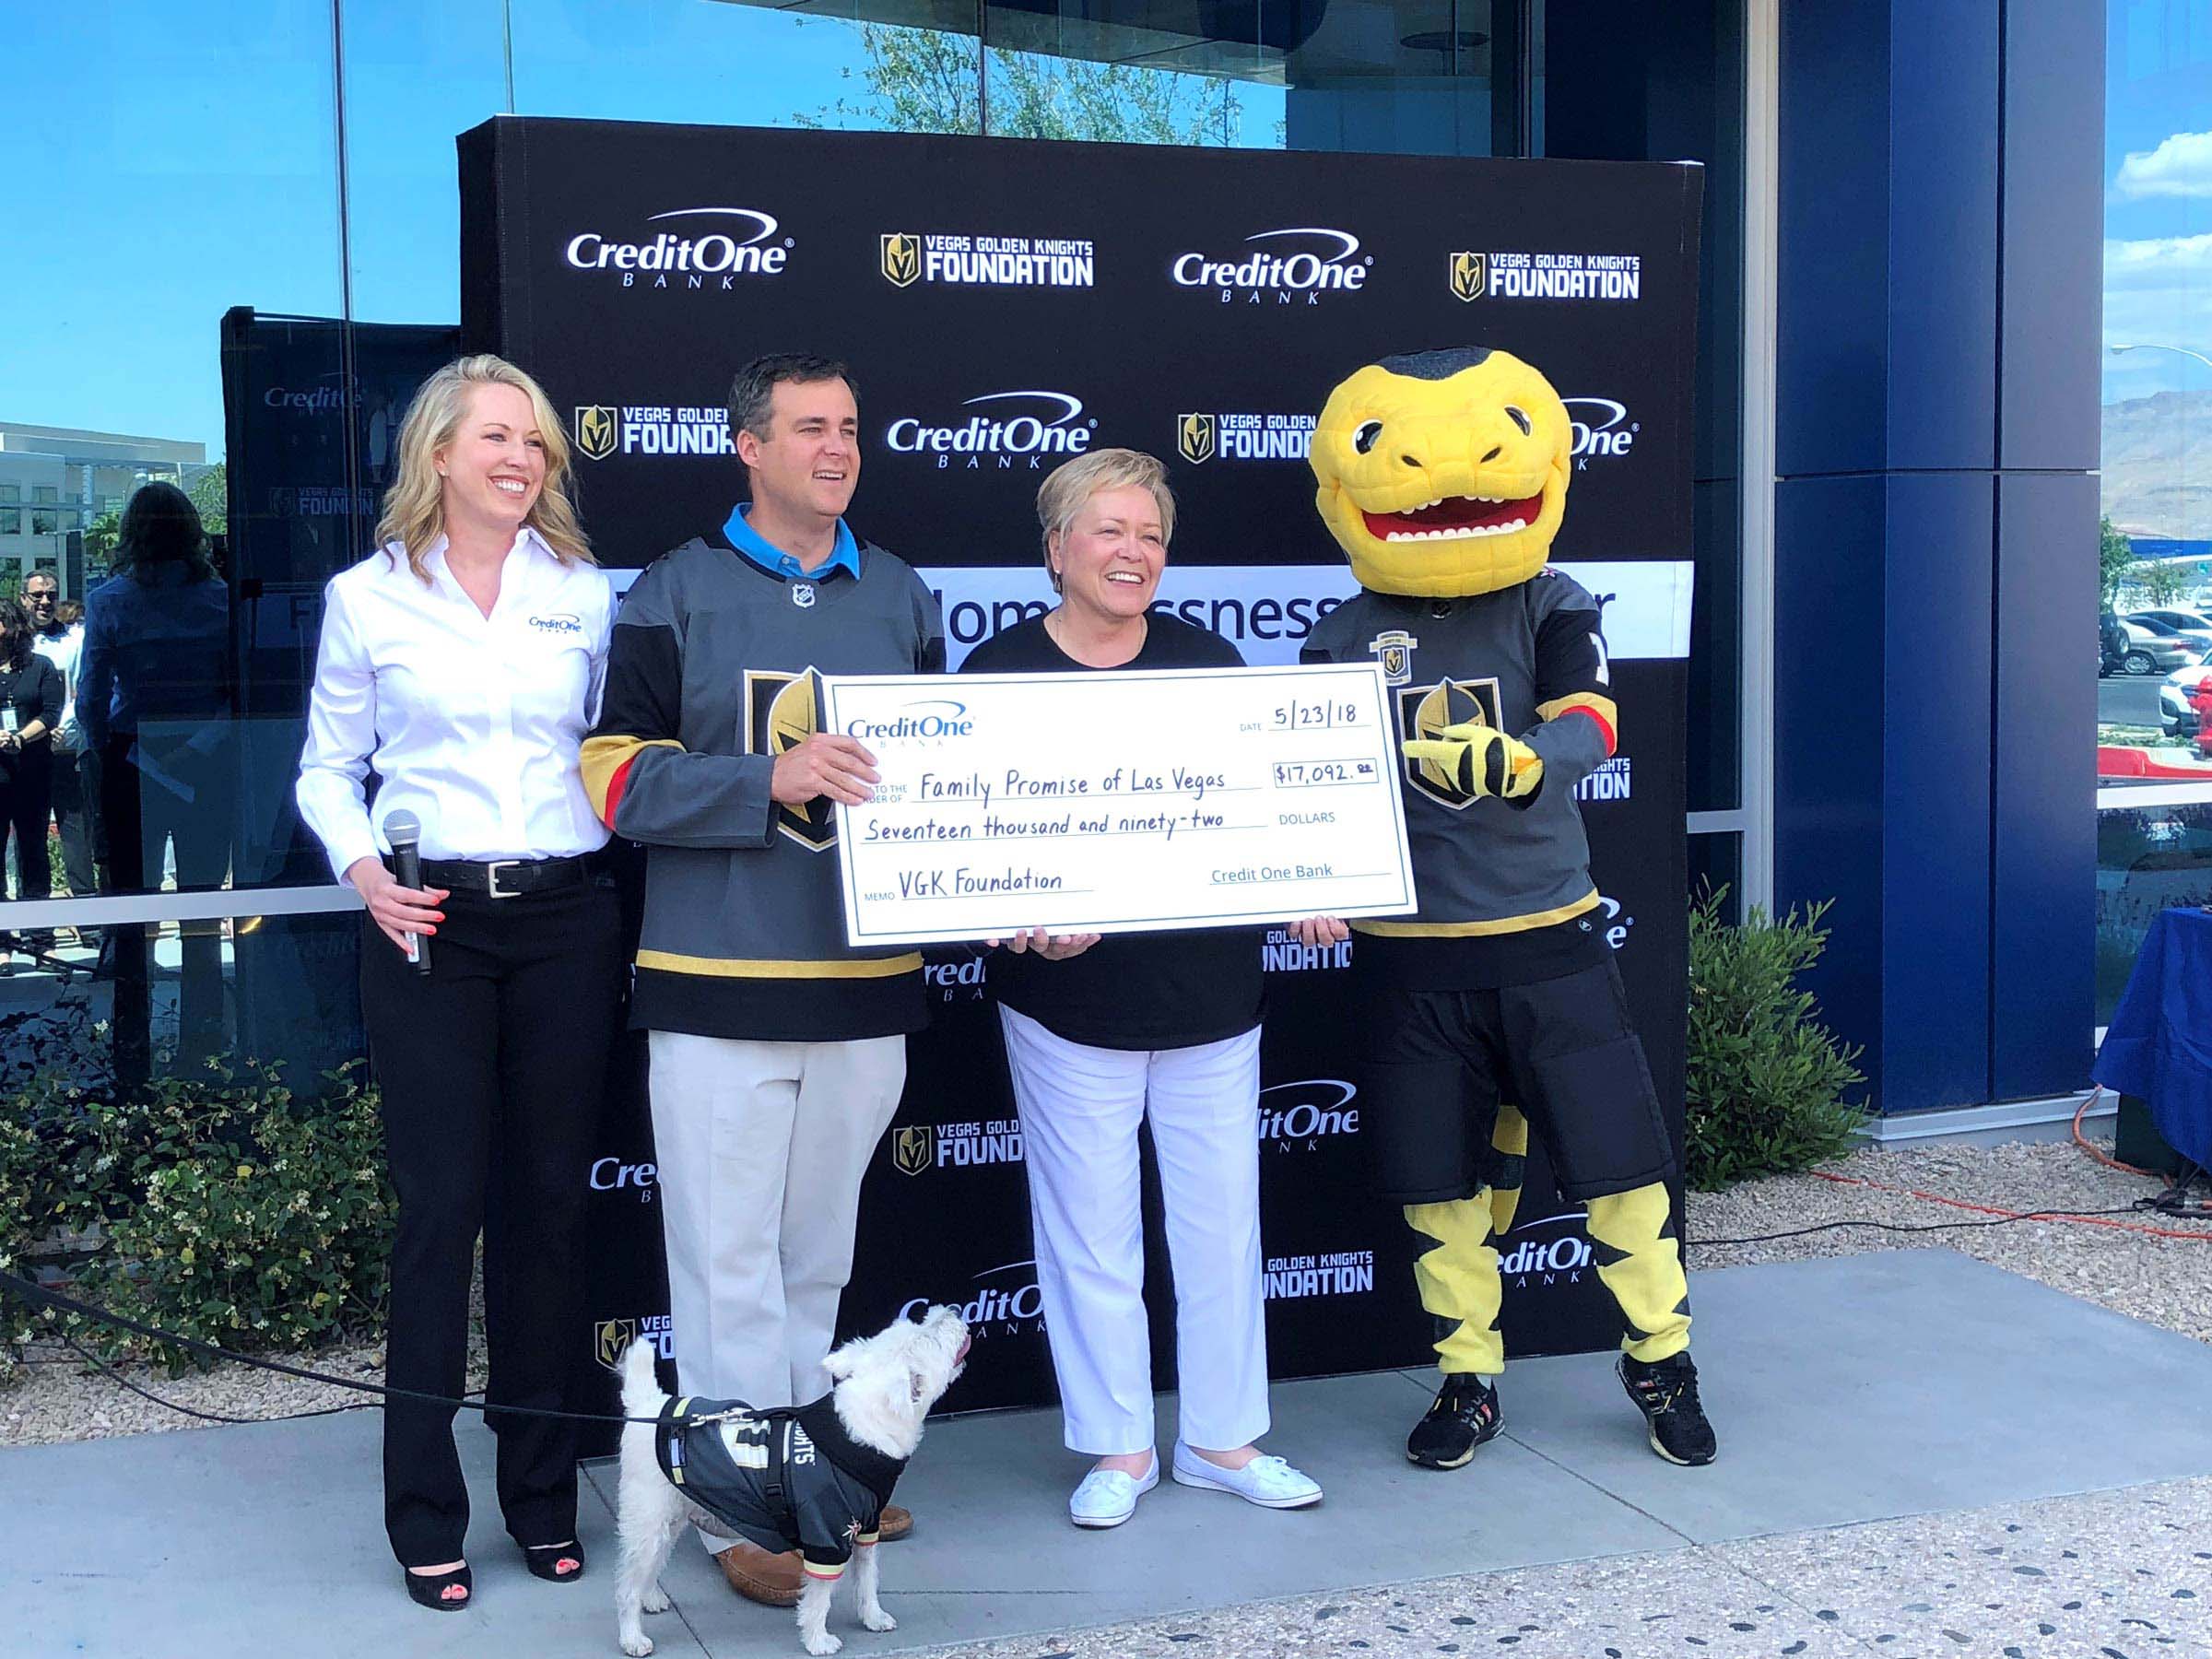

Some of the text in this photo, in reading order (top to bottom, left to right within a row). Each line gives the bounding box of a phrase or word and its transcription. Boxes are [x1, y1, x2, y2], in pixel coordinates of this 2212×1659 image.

[925, 235, 1094, 256] VEGAS GOLDEN KNIGHTS
[926, 251, 1094, 287] FOUNDATION
[1489, 253, 1641, 270] VEGAS GOLDEN KNIGHTS
[622, 273, 734, 289] BANK
[1489, 267, 1640, 299] FOUNDATION
[1221, 289, 1319, 305] BANK
[622, 406, 671, 422] VEGAS
[1219, 414, 1316, 429] VEGAS GOLDEN
[623, 423, 737, 454] FOUNDA
[1219, 429, 1314, 458] FOUND
[938, 455, 1041, 469] BANK
[1275, 700, 1357, 730] 5/23/18
[1240, 724, 1262, 732] DATE
[876, 784, 908, 794] TO THE
[922, 767, 1226, 809] Family Promise of Las Vegas
[889, 794, 902, 804] OF
[865, 808, 1225, 841] Seventeen thousand and ninety-two
[1278, 812, 1335, 826] DOLLARS
[899, 865, 1063, 898] VGK Foundation
[1211, 863, 1334, 883] Credit One Bank
[865, 891, 896, 901] MEMO
[936, 1119, 1021, 1138] VEGAS GOLD
[936, 1134, 1025, 1168] FOUND
[1267, 1251, 1373, 1271] GOLDEN KNIGHTS
[1516, 1271, 1581, 1288] ANK
[641, 1315, 671, 1331] VEG
[975, 1319, 1047, 1339] ANK
